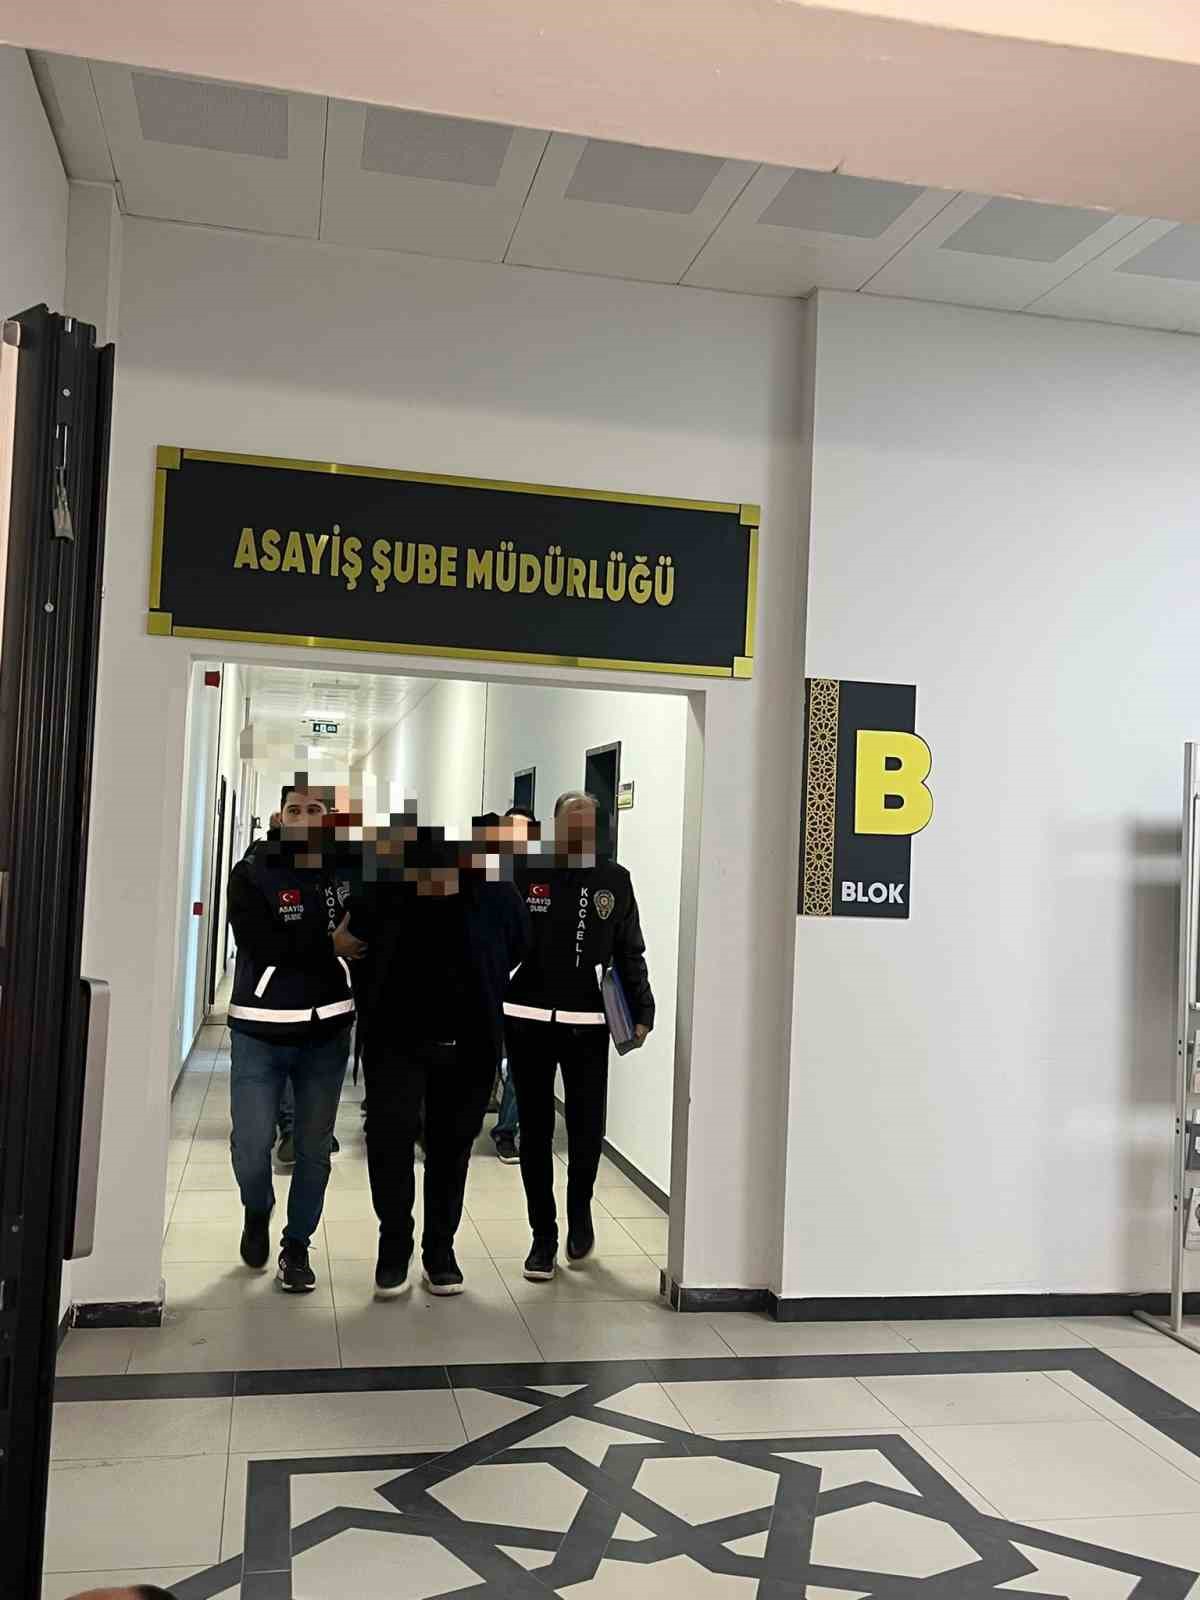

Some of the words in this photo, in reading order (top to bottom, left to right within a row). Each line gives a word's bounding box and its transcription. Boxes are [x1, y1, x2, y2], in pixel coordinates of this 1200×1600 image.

[233, 524, 363, 591] ASAYİŞ
[370, 538, 458, 593] ŞUBE
[466, 540, 675, 606] MÜDÜRLÜĞÜ
[853, 729, 934, 836] B
[324, 886, 336, 937] KOCA
[841, 881, 904, 904] BLOK
